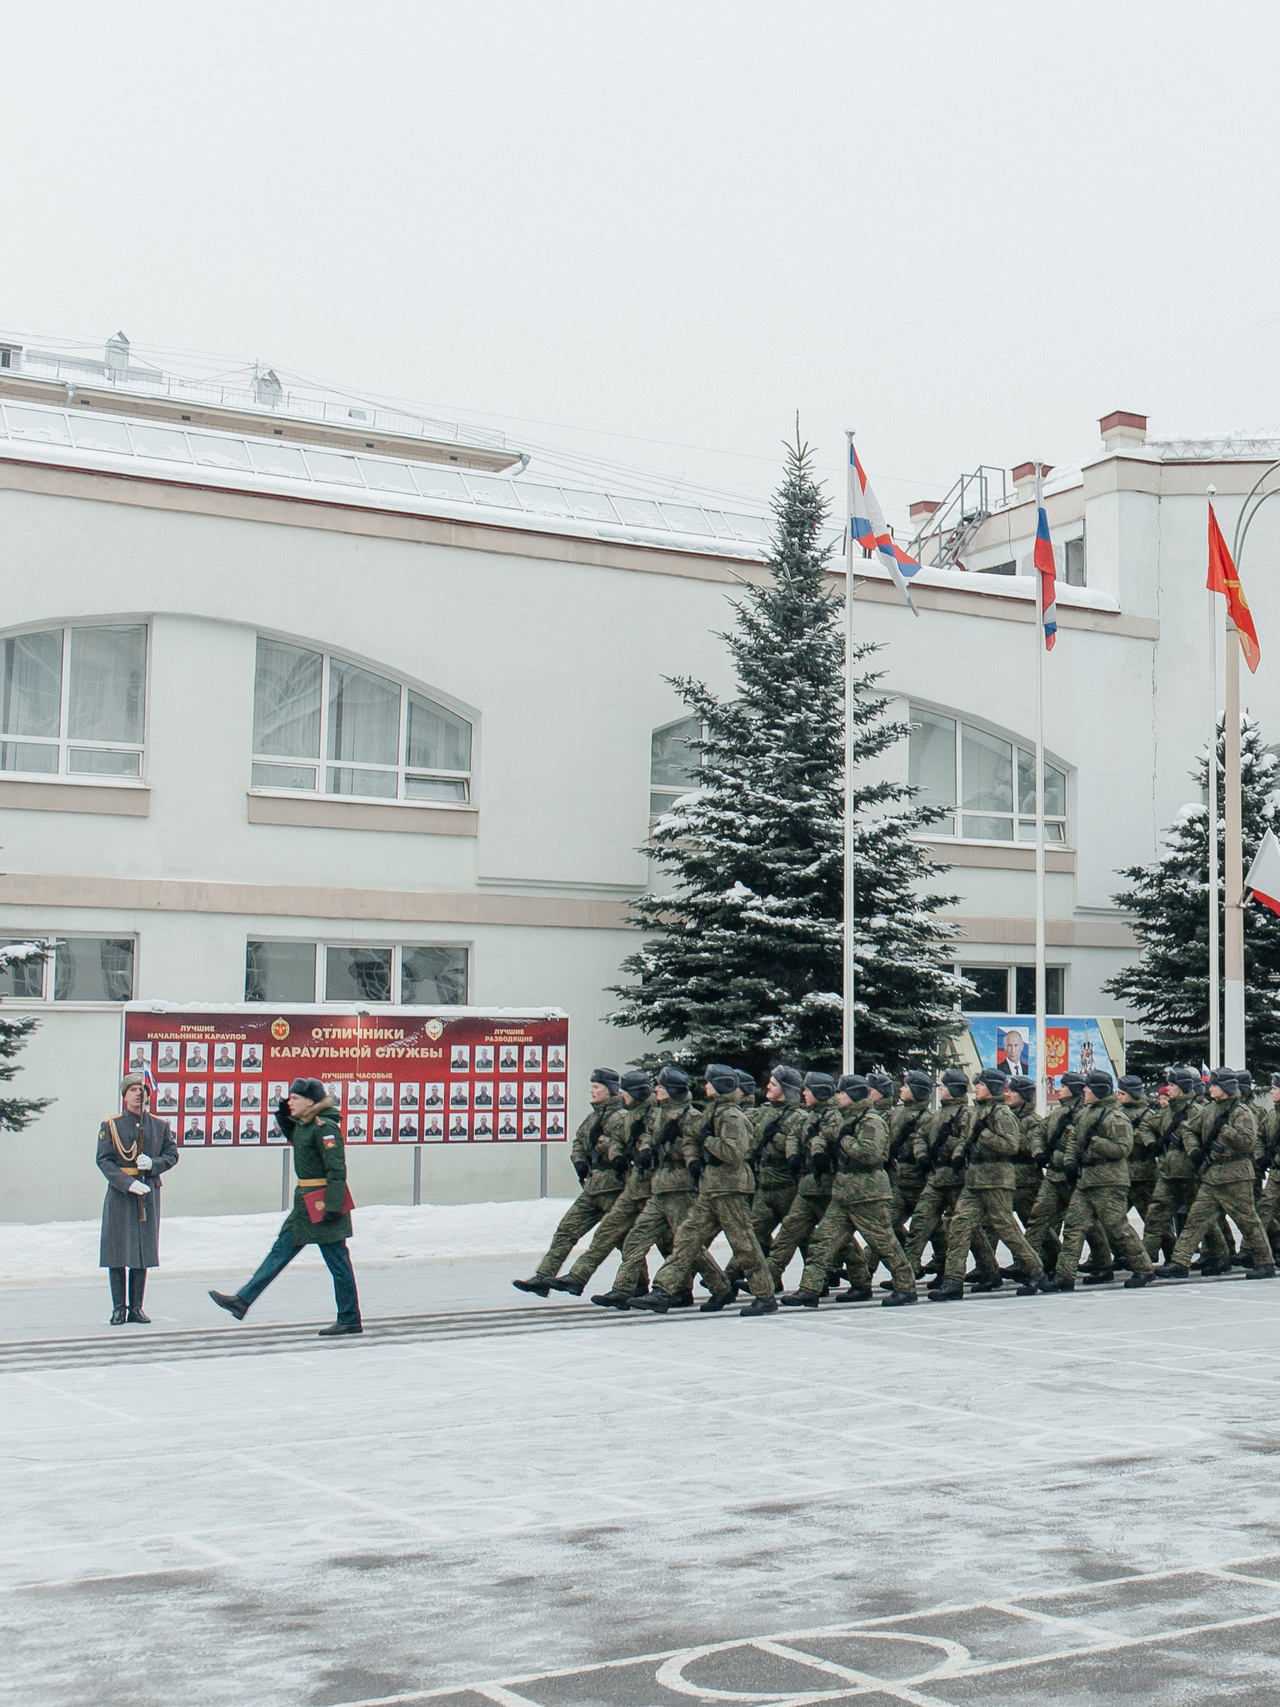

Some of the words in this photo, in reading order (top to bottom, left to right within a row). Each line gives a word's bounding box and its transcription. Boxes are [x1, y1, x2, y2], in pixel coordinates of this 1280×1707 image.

[147, 1032, 203, 1040] НАЧАЛЬНИКИ
[311, 1027, 405, 1040] ОТЛИЧНИКИ
[270, 1044, 372, 1058] КАРАУЛЬНОЙ
[375, 1046, 443, 1059] СЛУЖБЫ
